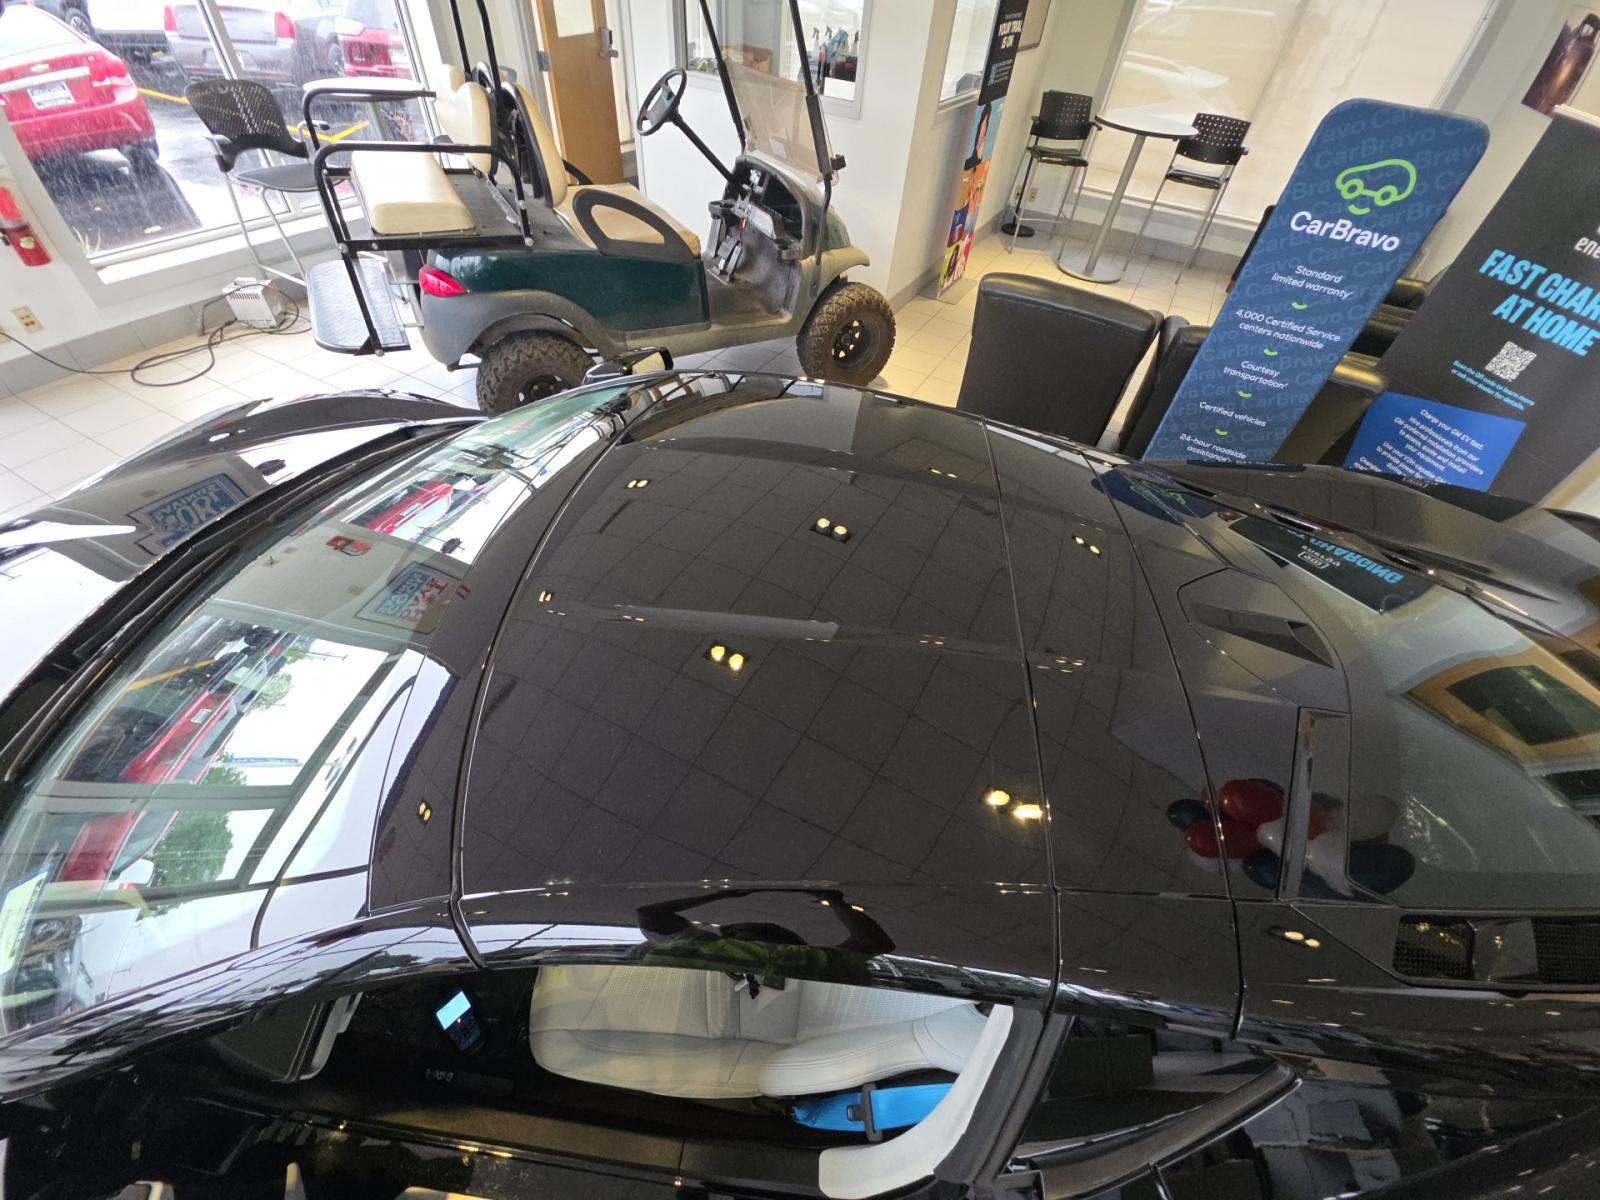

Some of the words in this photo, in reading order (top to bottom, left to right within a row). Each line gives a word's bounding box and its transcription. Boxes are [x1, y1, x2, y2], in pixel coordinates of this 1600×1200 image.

[1290, 211, 1400, 252] CarBravo
[1271, 272, 1304, 288] limited
[1295, 265, 1343, 283] Standard
[1479, 248, 1547, 290] FAST
[1235, 309, 1265, 322] 4,000
[1265, 315, 1306, 333] Certified
[1305, 326, 1341, 342] Service
[1239, 322, 1272, 336] centers
[1272, 330, 1325, 350] nationwide
[1492, 294, 1535, 324] AT
[1523, 305, 1600, 357] HOME
[1241, 360, 1280, 378] Courtesy
[1199, 401, 1234, 418] Certified
[1234, 412, 1267, 427] vehicles
[1179, 433, 1212, 448] 24-hour
[1212, 443, 1247, 460] roadside
